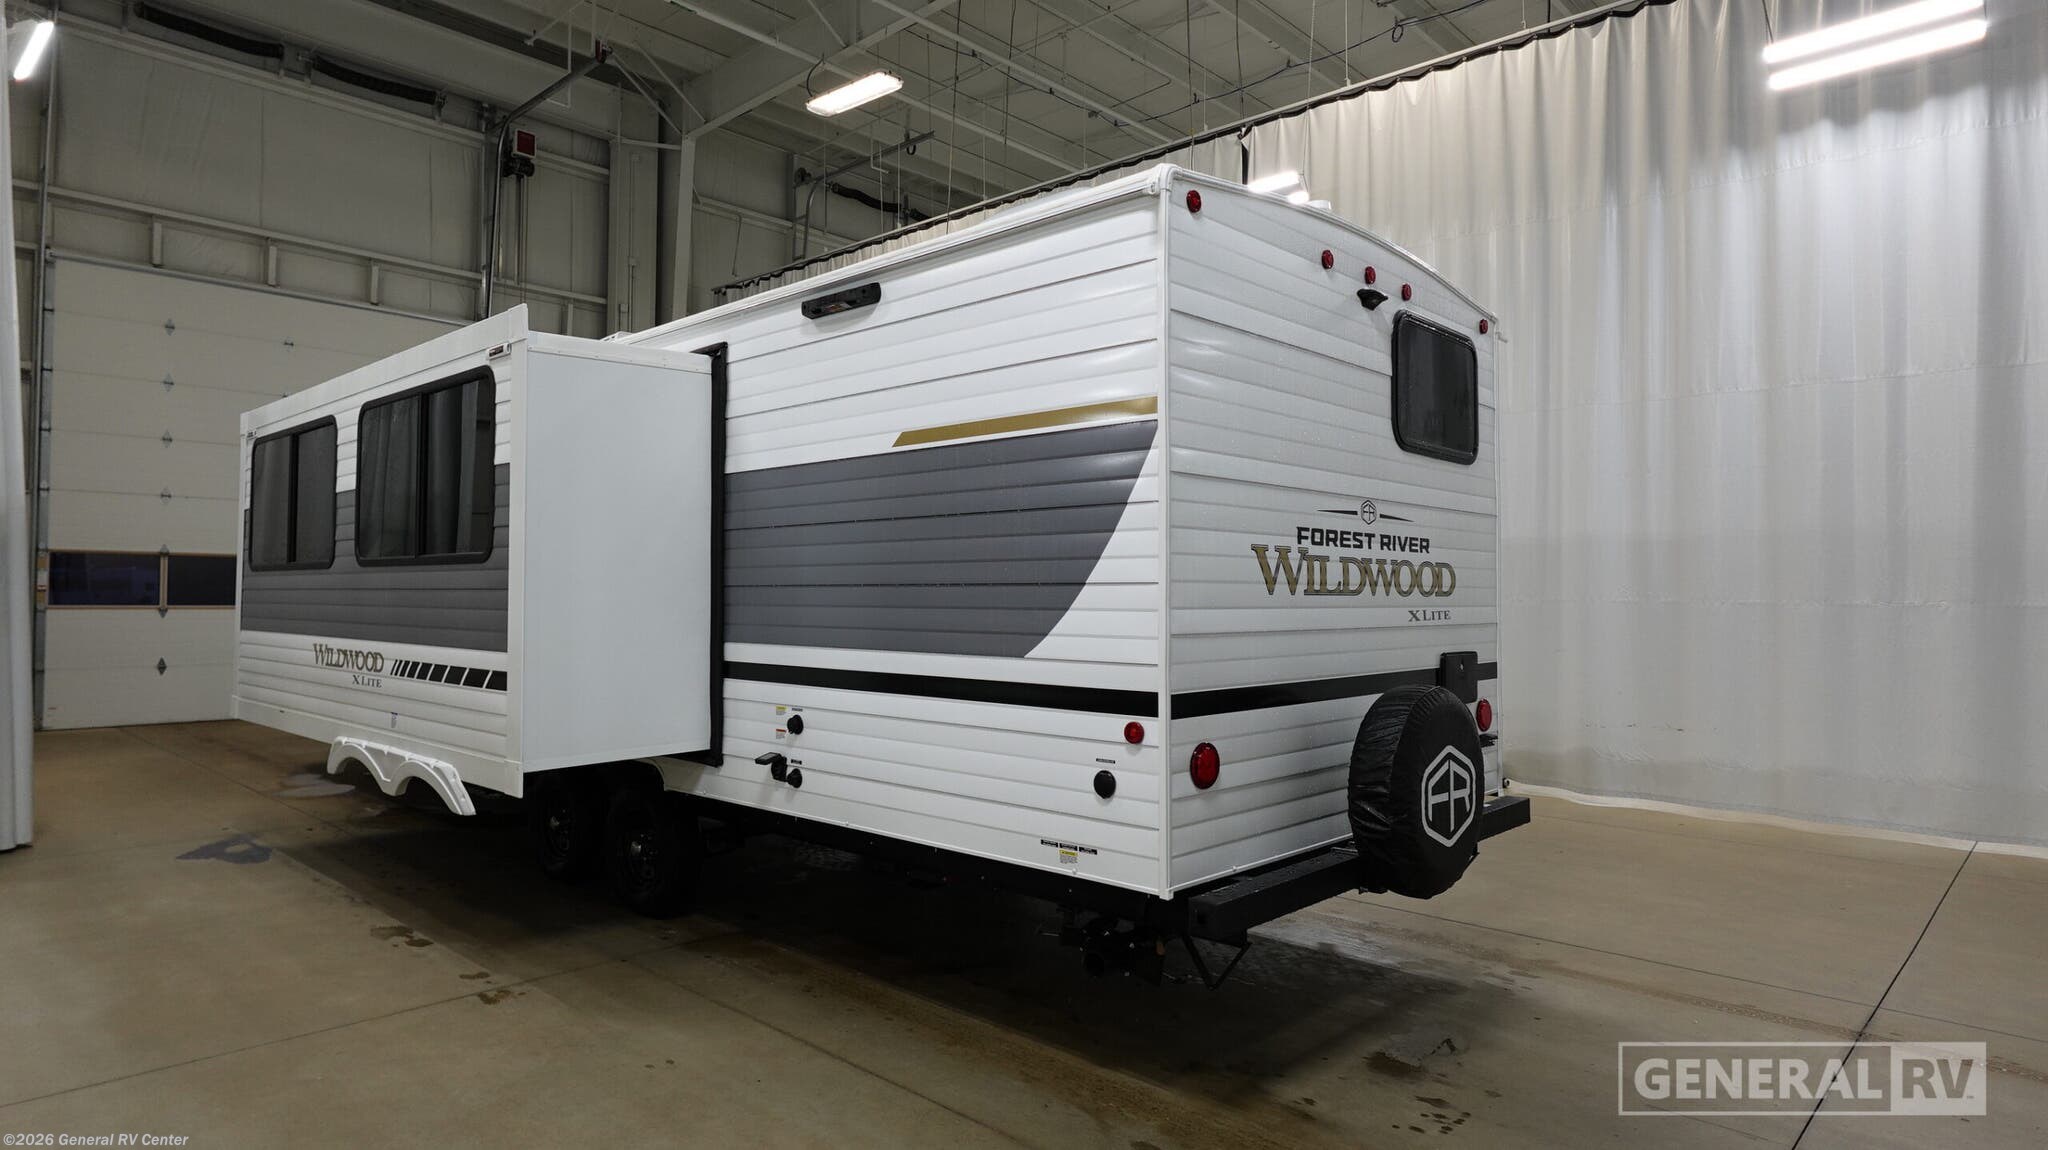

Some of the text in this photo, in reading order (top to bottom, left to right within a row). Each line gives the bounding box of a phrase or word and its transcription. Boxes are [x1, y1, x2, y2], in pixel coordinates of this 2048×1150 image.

[1296, 526, 1430, 554] FOREST RIVER
[1250, 543, 1457, 598] WILDWOOD
[1408, 609, 1451, 622] X LITE
[313, 643, 385, 673] WILDWOOD
[352, 674, 382, 688] X LITE
